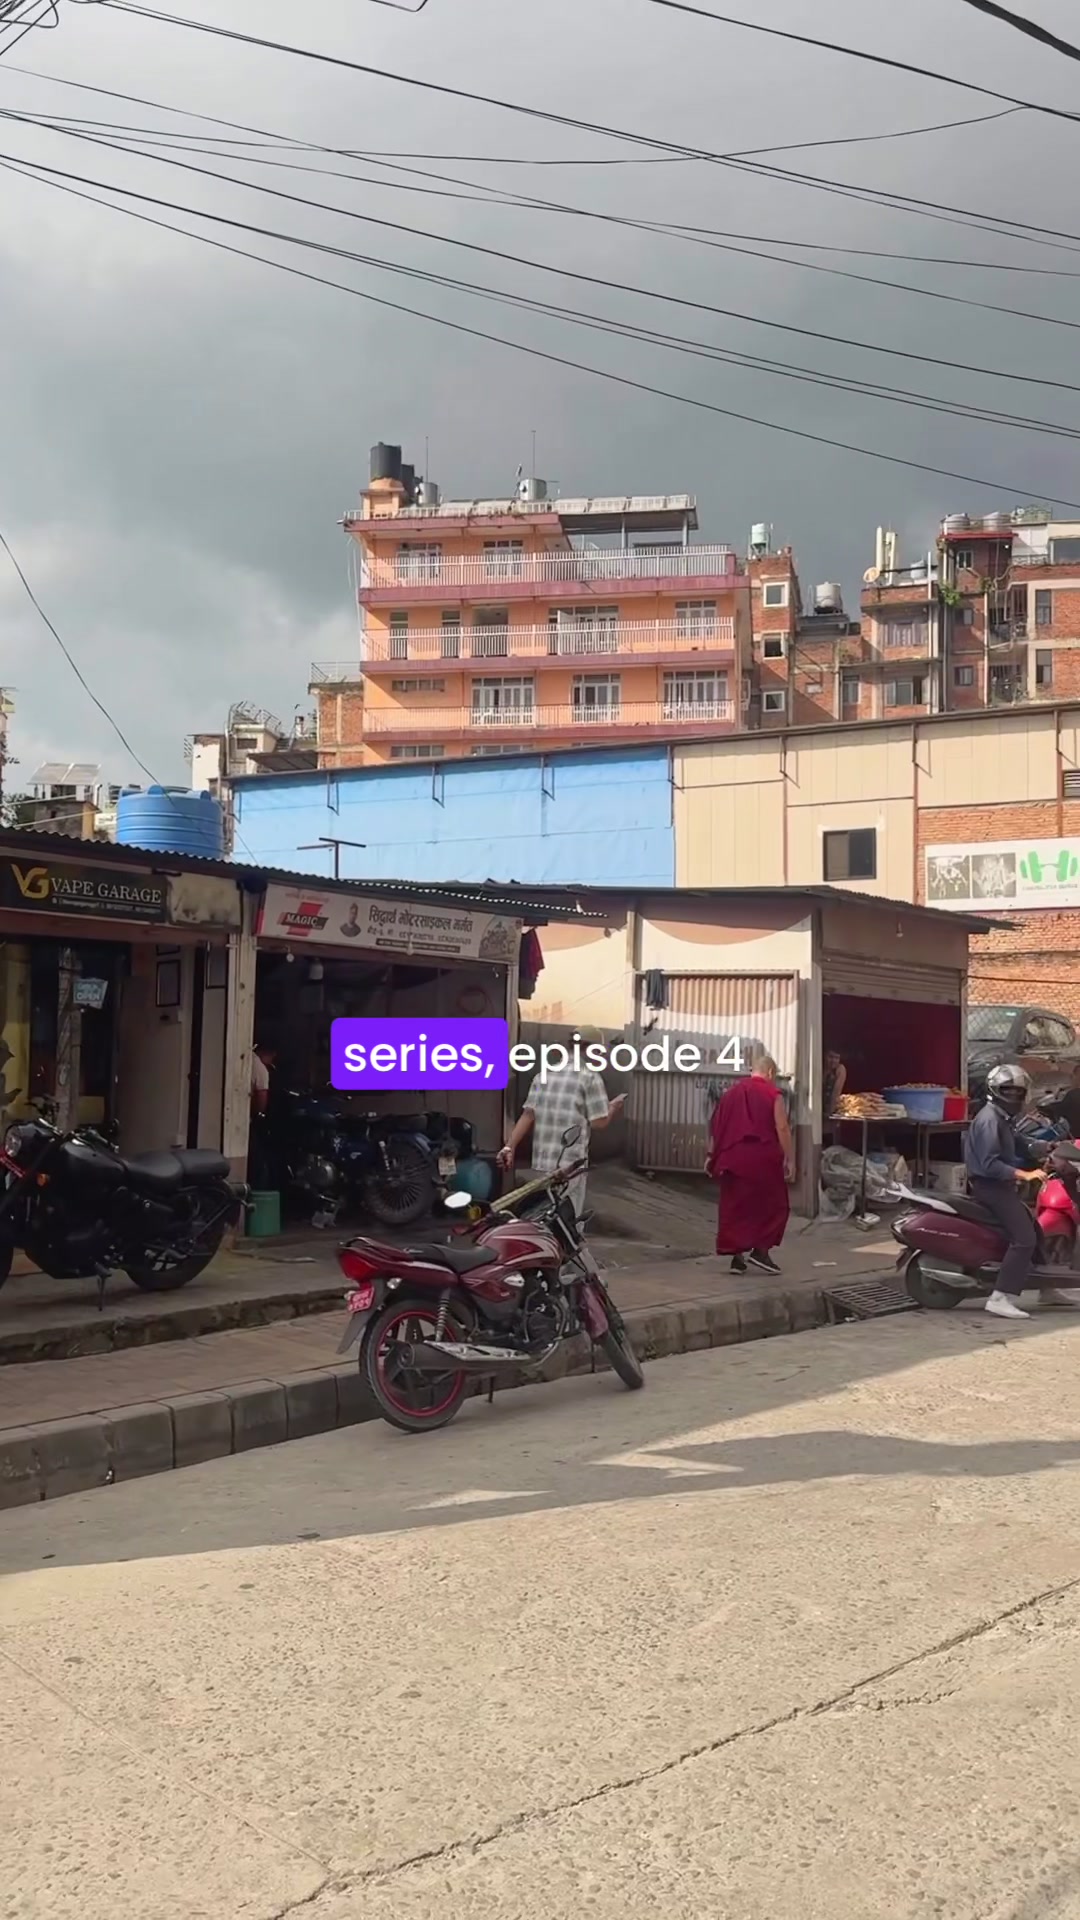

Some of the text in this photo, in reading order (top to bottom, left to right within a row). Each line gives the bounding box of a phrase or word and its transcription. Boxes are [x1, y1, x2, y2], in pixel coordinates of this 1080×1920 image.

[10, 863, 50, 899] VG
[51, 877, 162, 904] VAPE GARAGE
[285, 913, 319, 927] MAGIC
